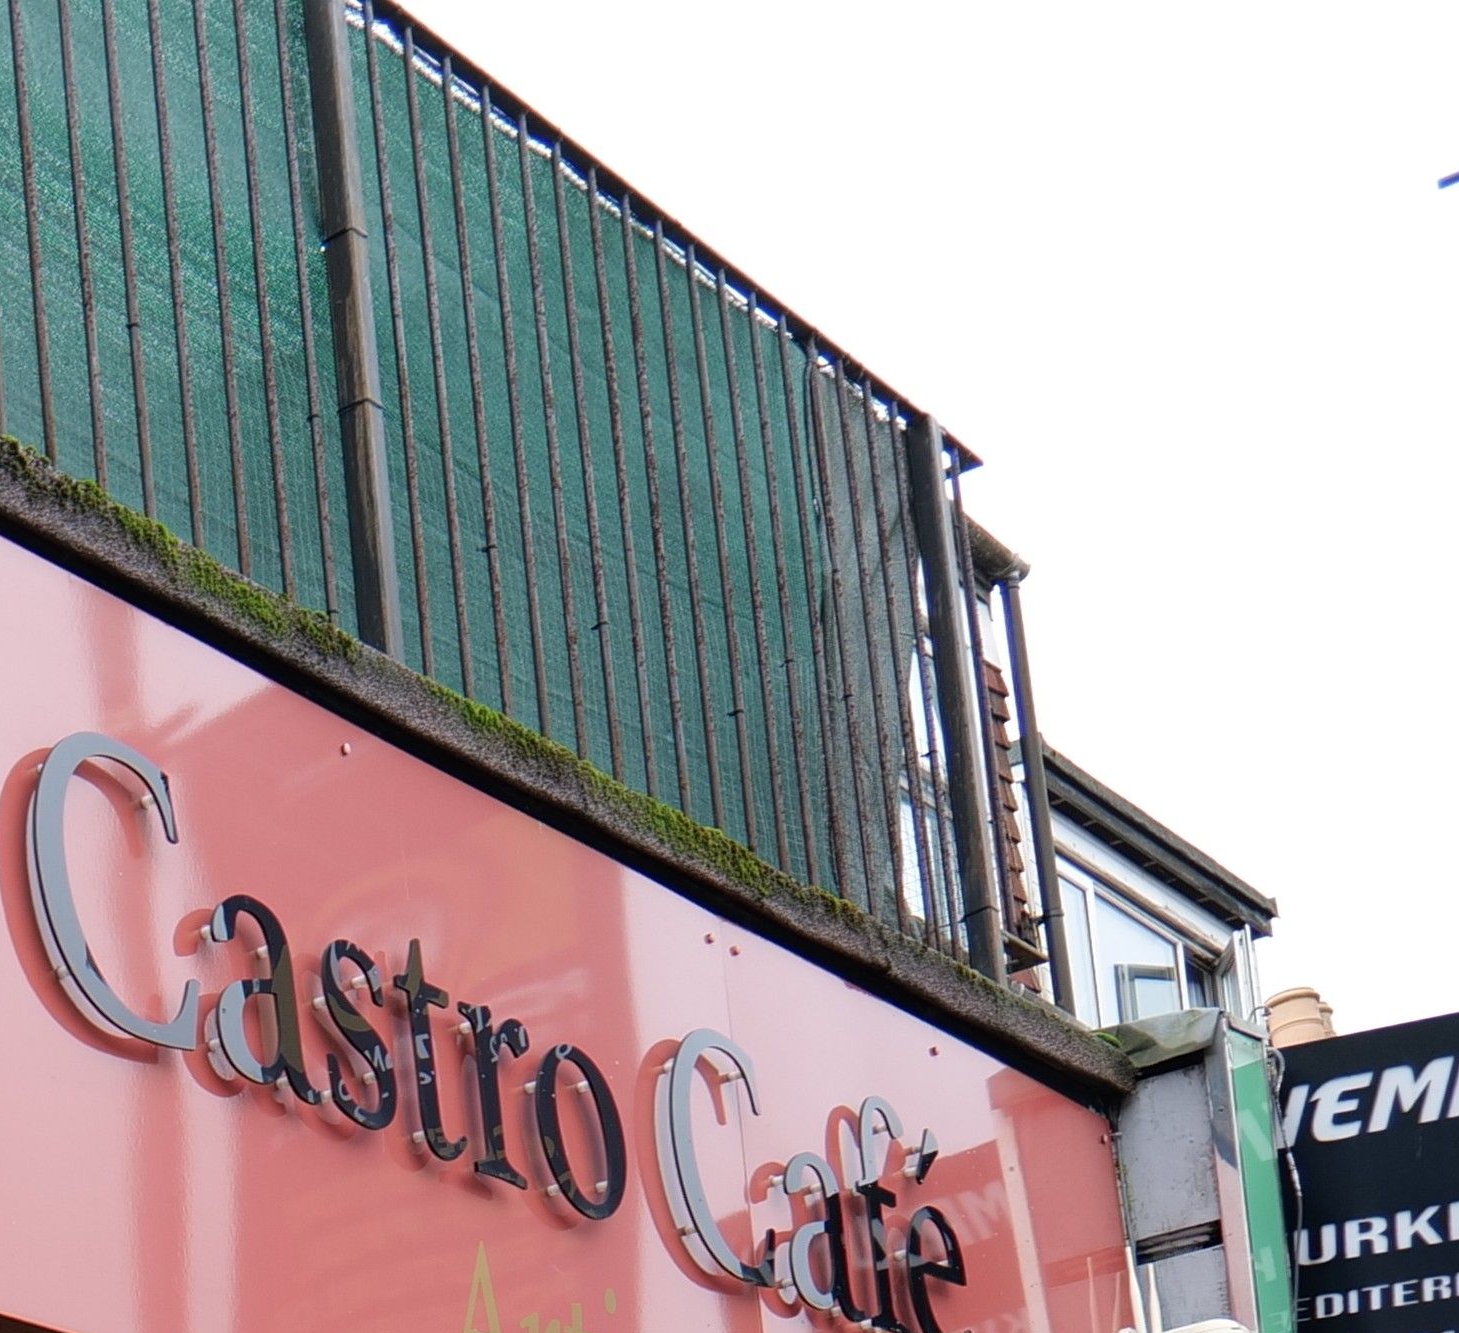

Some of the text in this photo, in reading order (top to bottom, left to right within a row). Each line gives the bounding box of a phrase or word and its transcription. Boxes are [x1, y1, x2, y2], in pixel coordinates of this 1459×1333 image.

[26, 731, 628, 1222] Castro
[1293, 1200, 1459, 1266] URKI
[1296, 1272, 1459, 1323] EDITER
